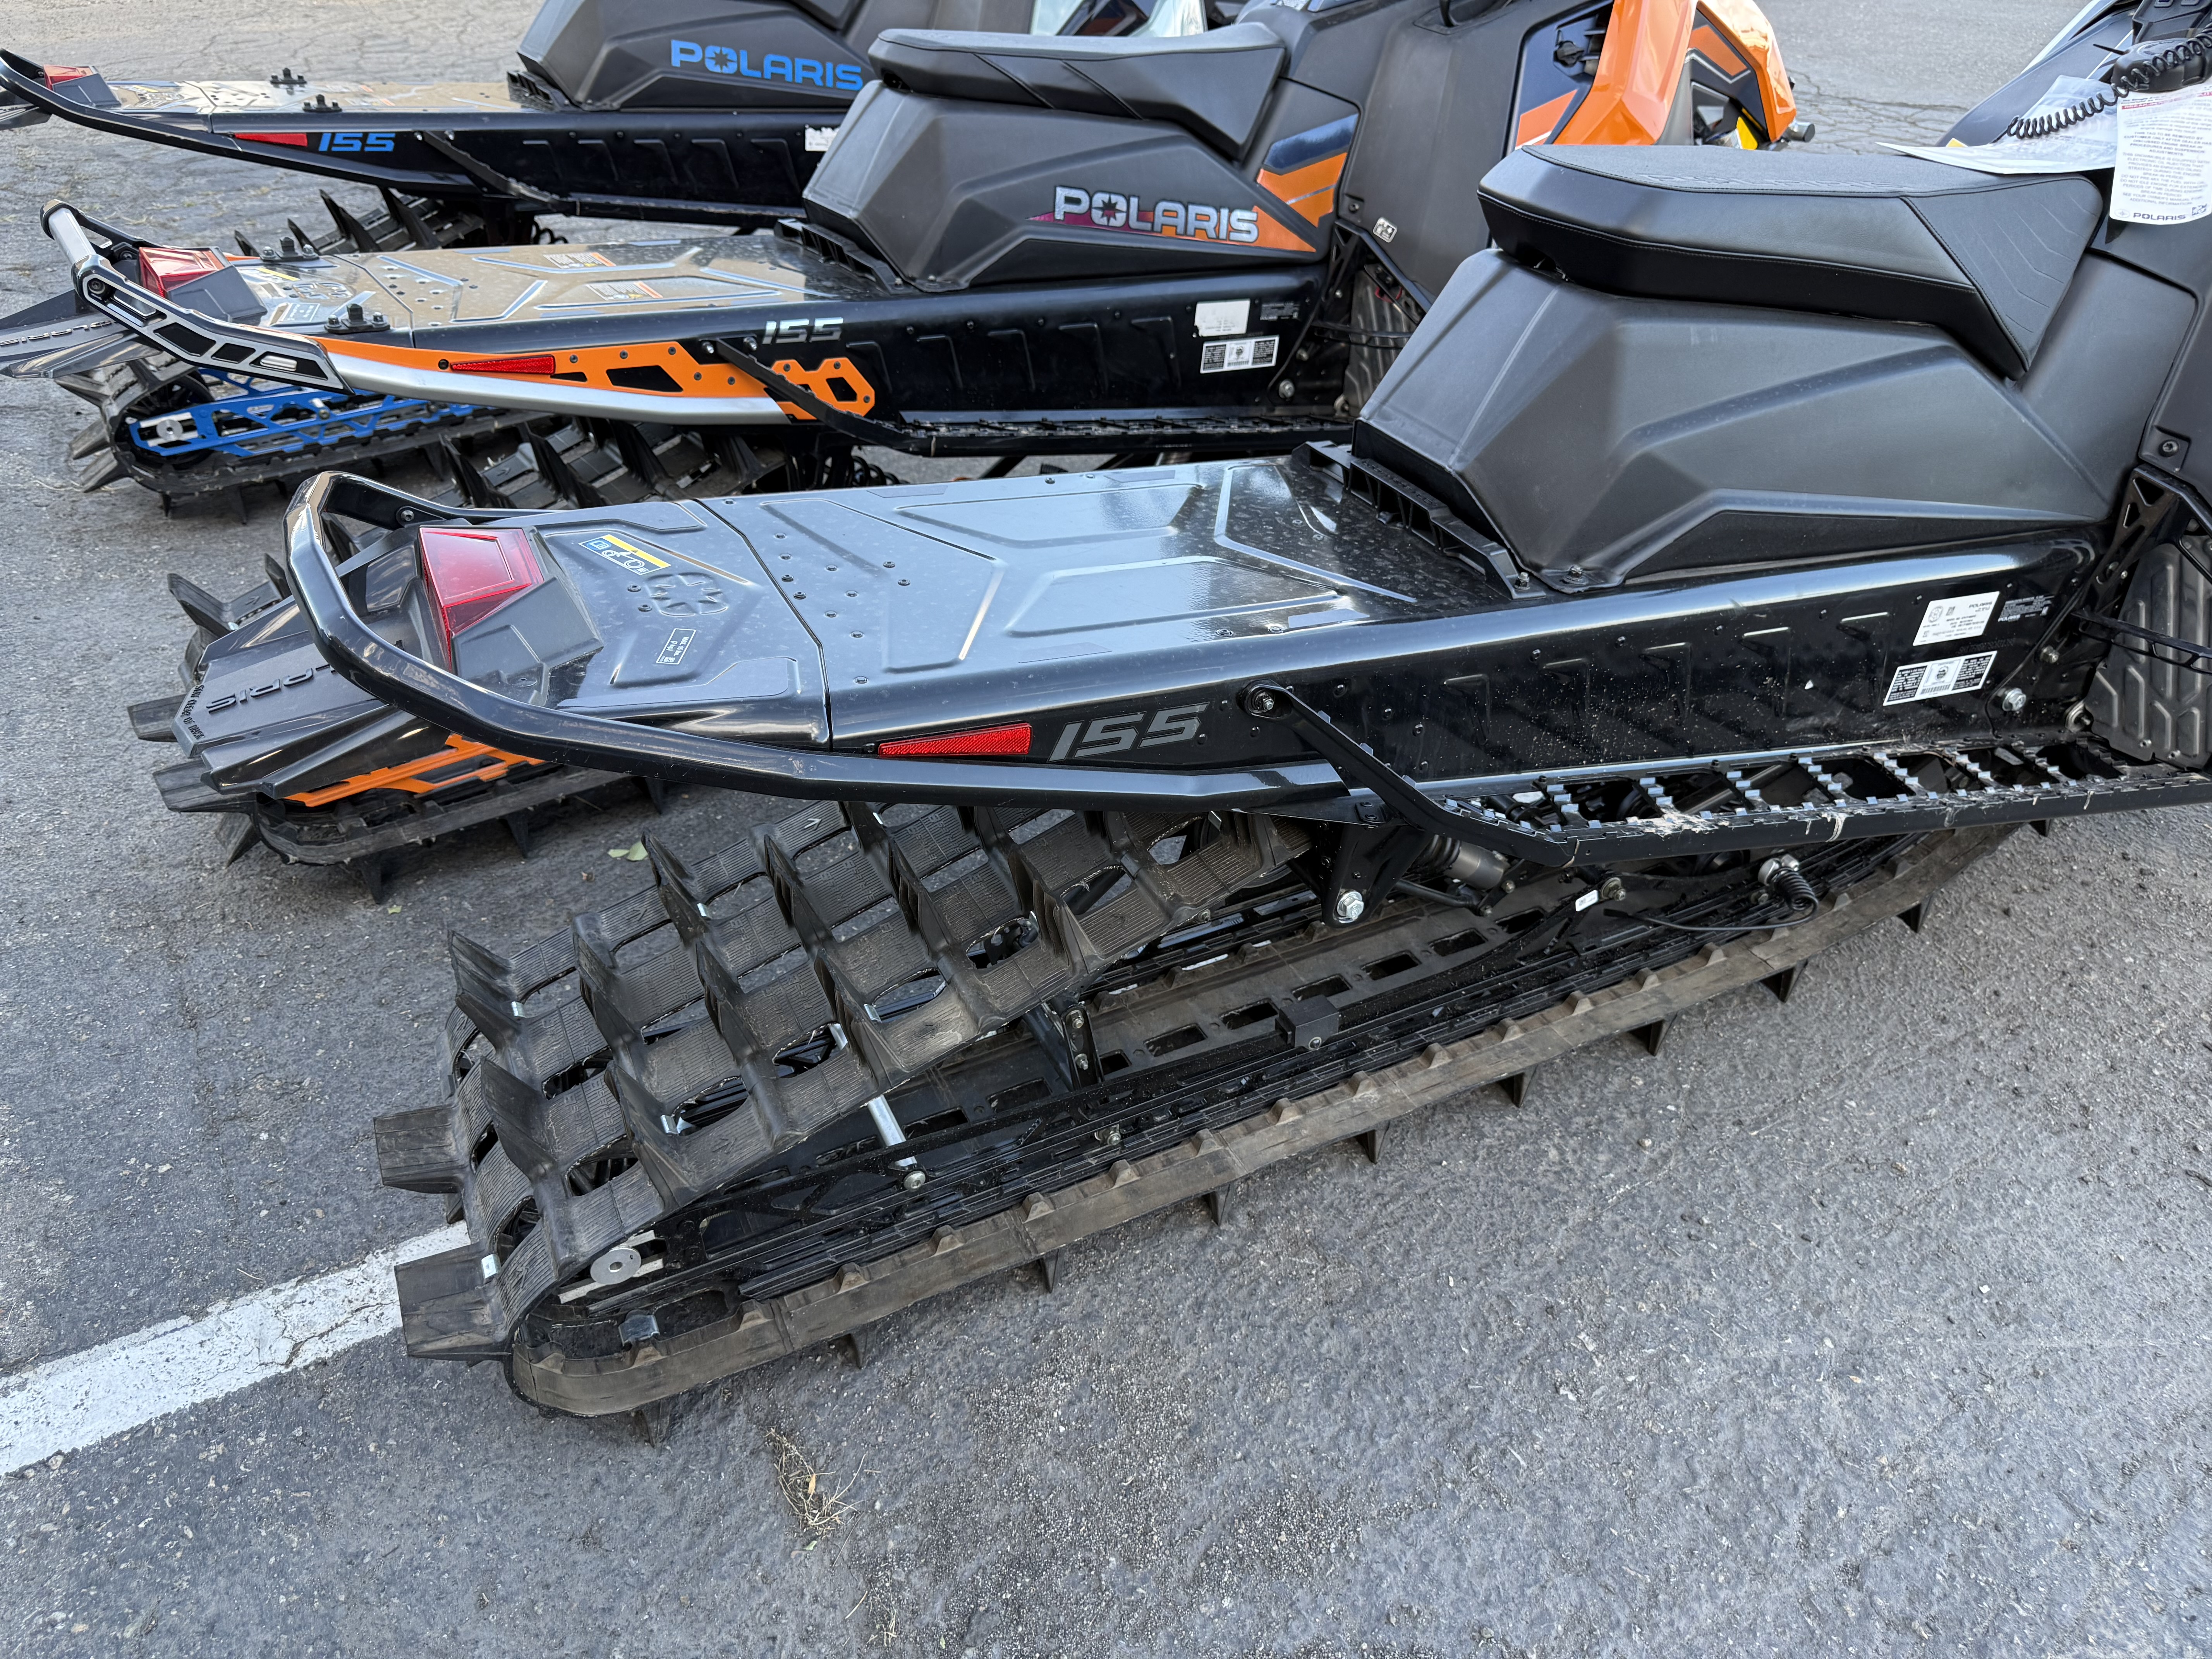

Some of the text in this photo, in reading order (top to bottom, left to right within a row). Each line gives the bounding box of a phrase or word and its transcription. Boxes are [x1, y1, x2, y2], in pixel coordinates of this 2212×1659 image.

[671, 39, 863, 91] POLARIS
[318, 132, 396, 152] 155
[1053, 185, 1259, 244] POLARIS
[2133, 212, 2186, 221] POLARIS
[761, 317, 844, 345] 155
[1048, 702, 1210, 763] 155
